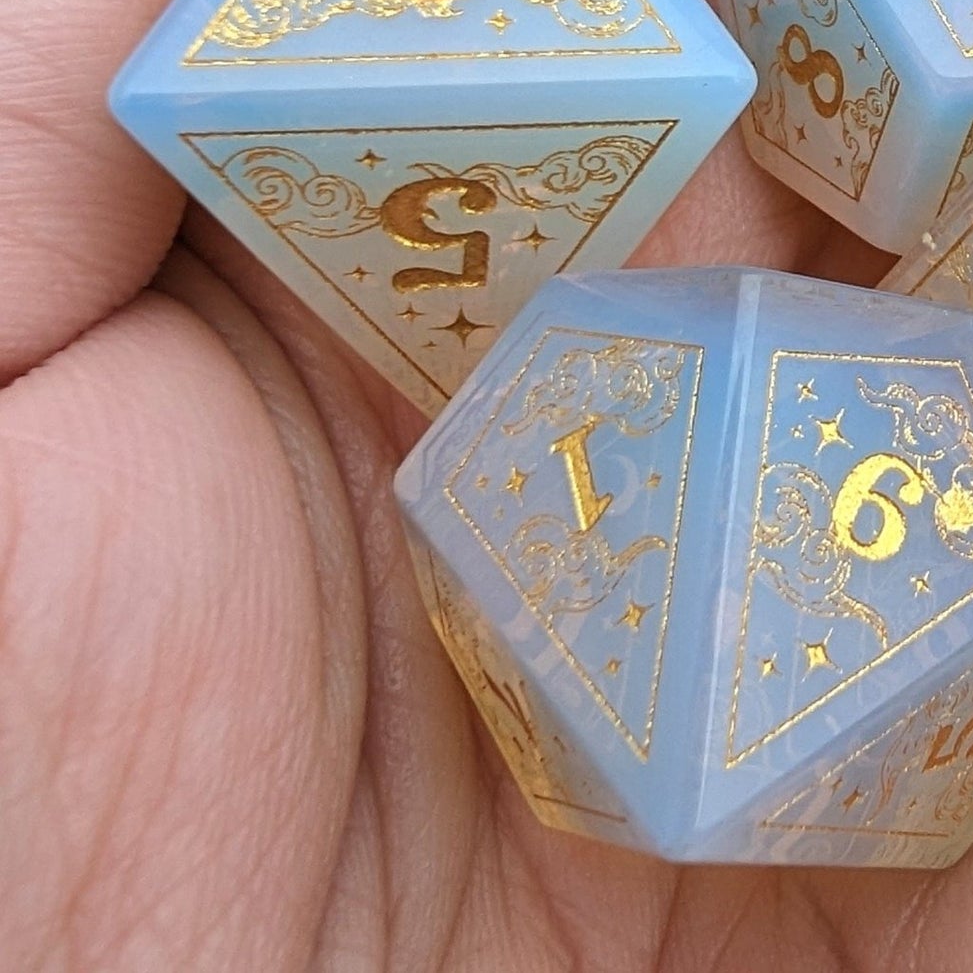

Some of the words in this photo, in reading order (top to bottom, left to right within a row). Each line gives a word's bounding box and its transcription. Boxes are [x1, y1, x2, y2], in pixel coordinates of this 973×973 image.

[782, 23, 844, 118] 8
[381, 177, 498, 295] 5
[550, 420, 615, 533] 1
